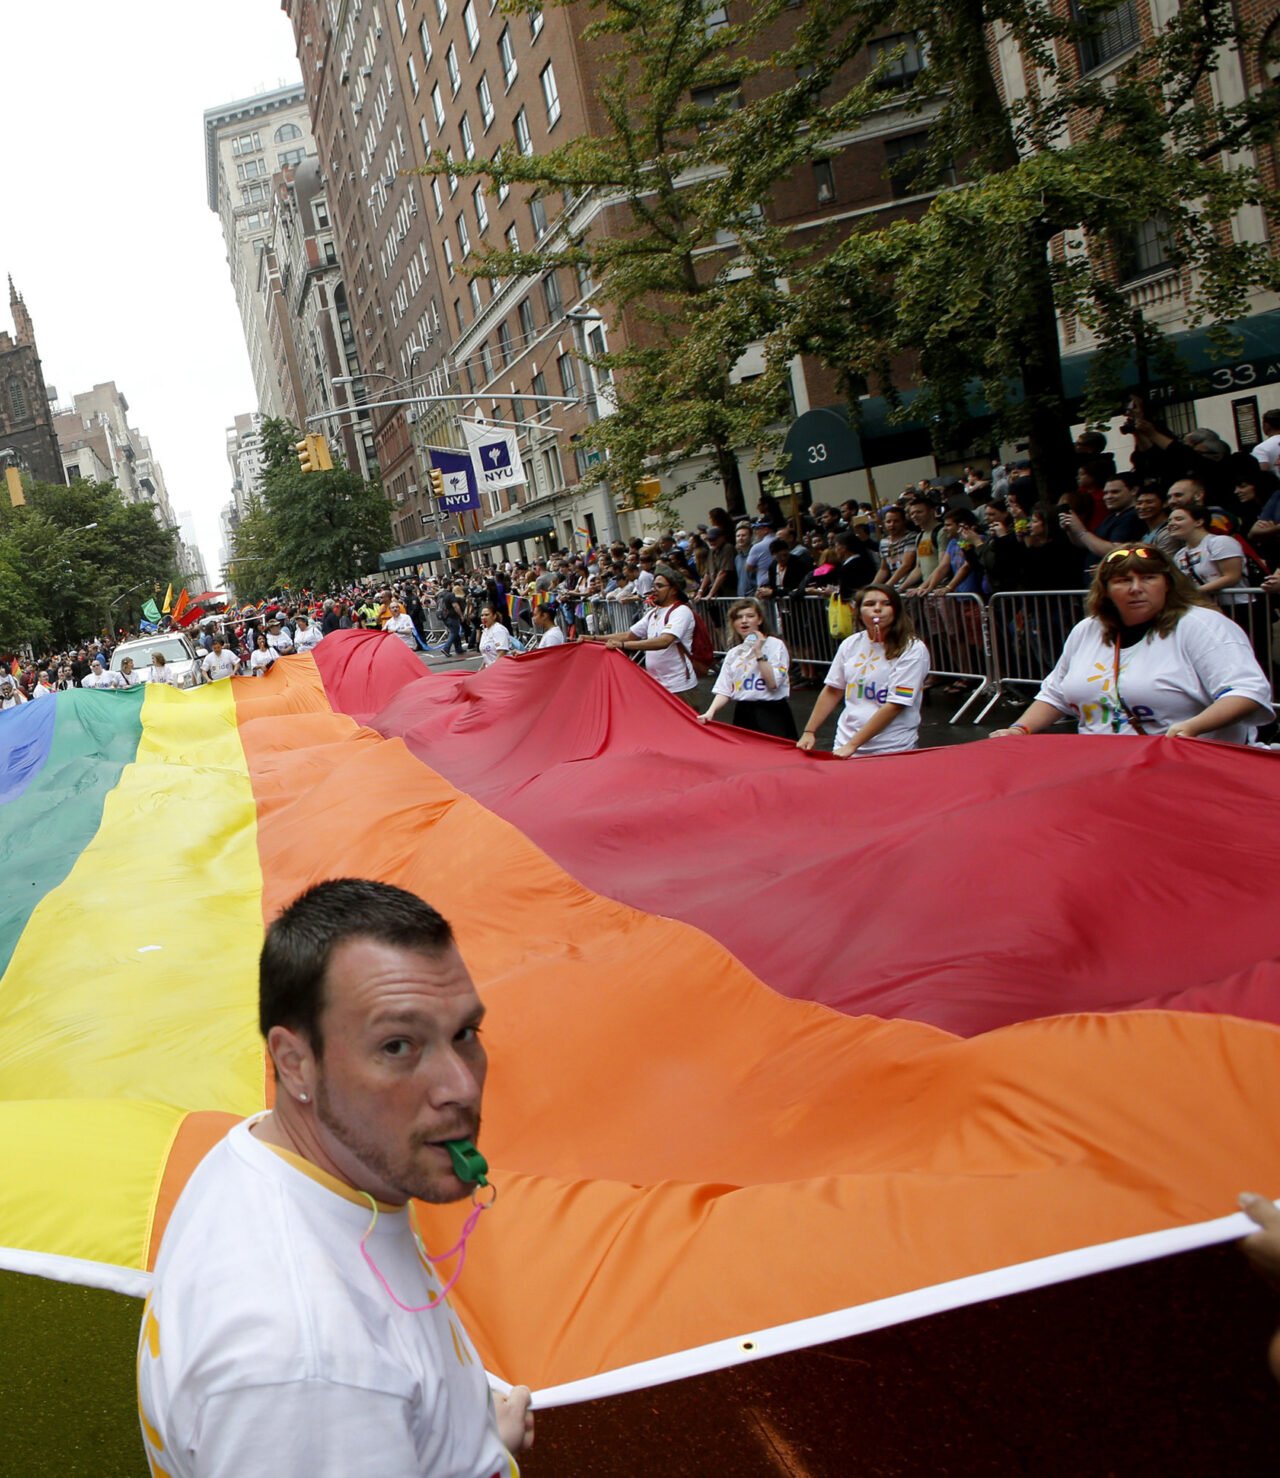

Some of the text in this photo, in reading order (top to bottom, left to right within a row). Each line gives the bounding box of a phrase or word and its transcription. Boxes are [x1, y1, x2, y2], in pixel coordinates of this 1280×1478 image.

[1212, 363, 1257, 389] 33
[807, 443, 827, 464] 33
[485, 467, 514, 482] NYU
[445, 494, 471, 506] NYU
